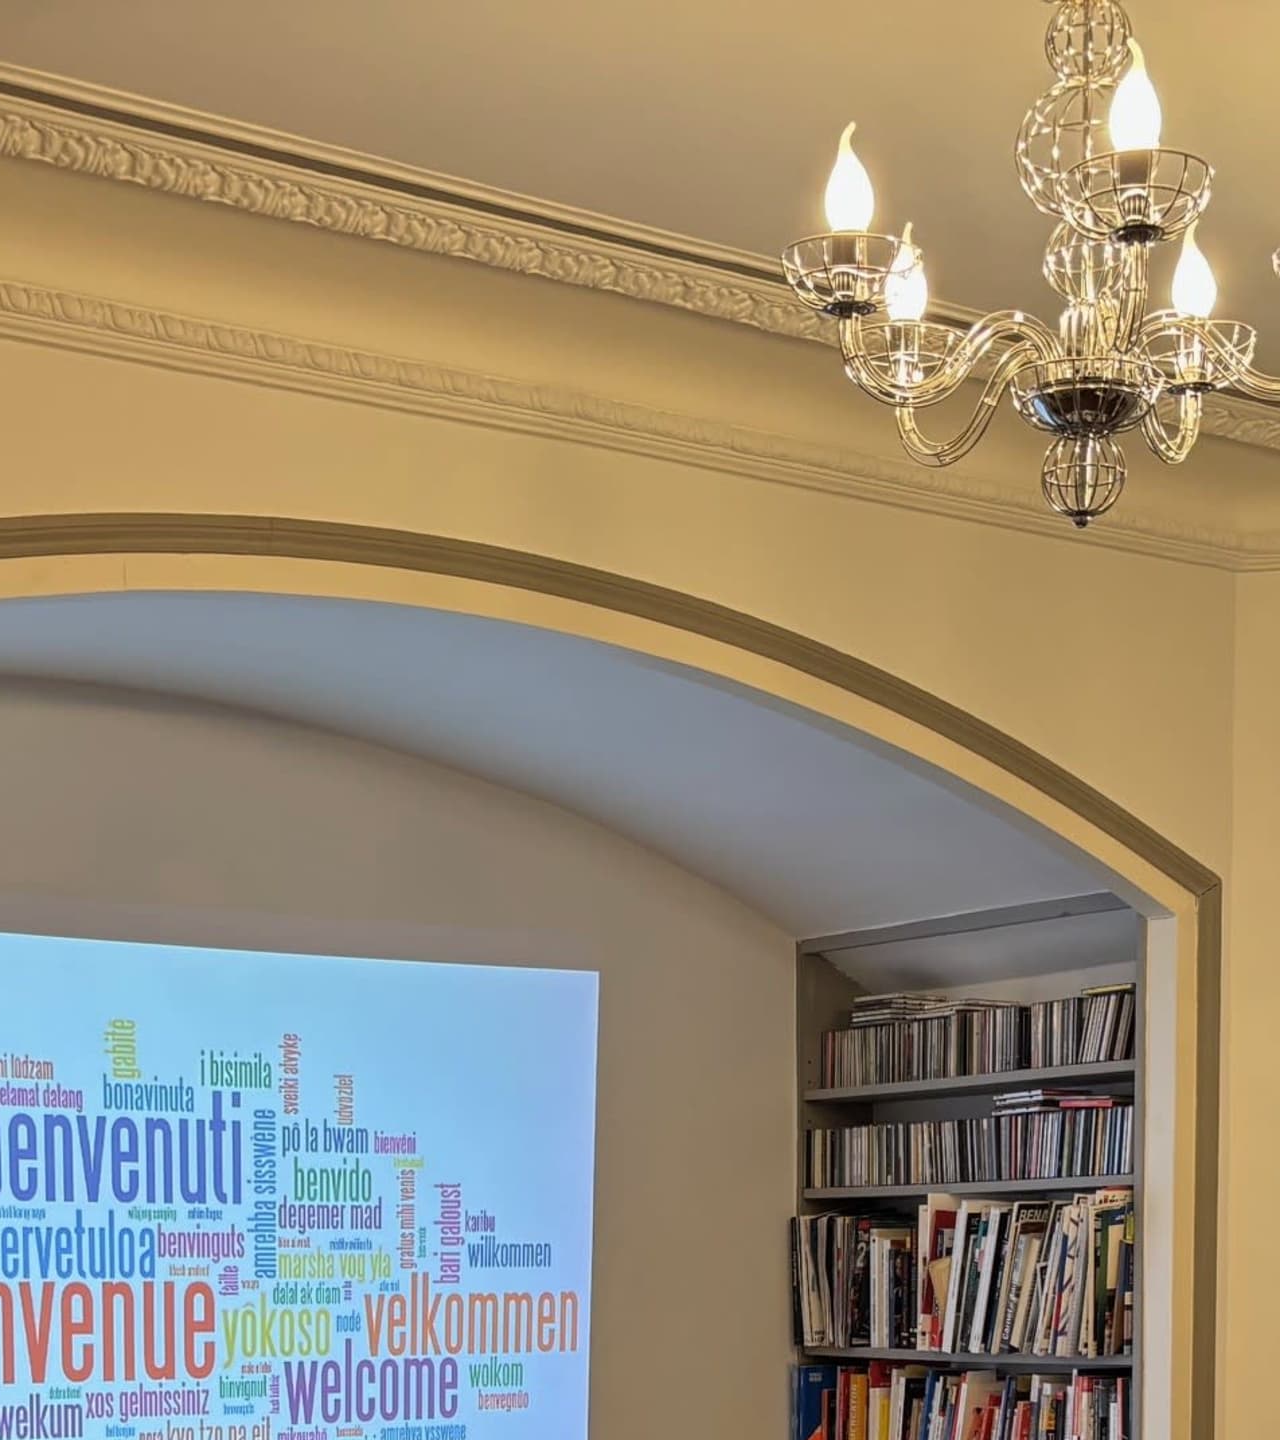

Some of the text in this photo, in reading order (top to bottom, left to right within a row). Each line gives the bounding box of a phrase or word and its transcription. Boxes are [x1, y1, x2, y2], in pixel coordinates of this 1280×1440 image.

[200, 1050, 272, 1089] i bisimila
[42, 1083, 83, 1113] datang
[103, 1073, 195, 1114] bonavinuta
[282, 1118, 369, 1157] pô la bwam
[294, 1156, 372, 1203] benvido
[396, 1169, 416, 1202] venis
[278, 1194, 382, 1235] degemer mad
[396, 1203, 416, 1232] mihi
[433, 1183, 465, 1284] bari galoust
[464, 1210, 496, 1233] karibu
[157, 1223, 245, 1264] benvinguts
[247, 1200, 276, 1280] amrehba
[396, 1233, 417, 1270] gratus
[467, 1235, 552, 1269] willkommen
[278, 1245, 335, 1280] marsha
[340, 1254, 365, 1284] vog
[273, 1281, 298, 1306] dalal
[300, 1281, 313, 1305] ak
[221, 1291, 332, 1370] yôkoso
[364, 1271, 579, 1358] velkommen
[284, 1337, 459, 1425] welcome
[469, 1355, 523, 1388] wolkom
[85, 1381, 210, 1423] xos gelmissiniz
